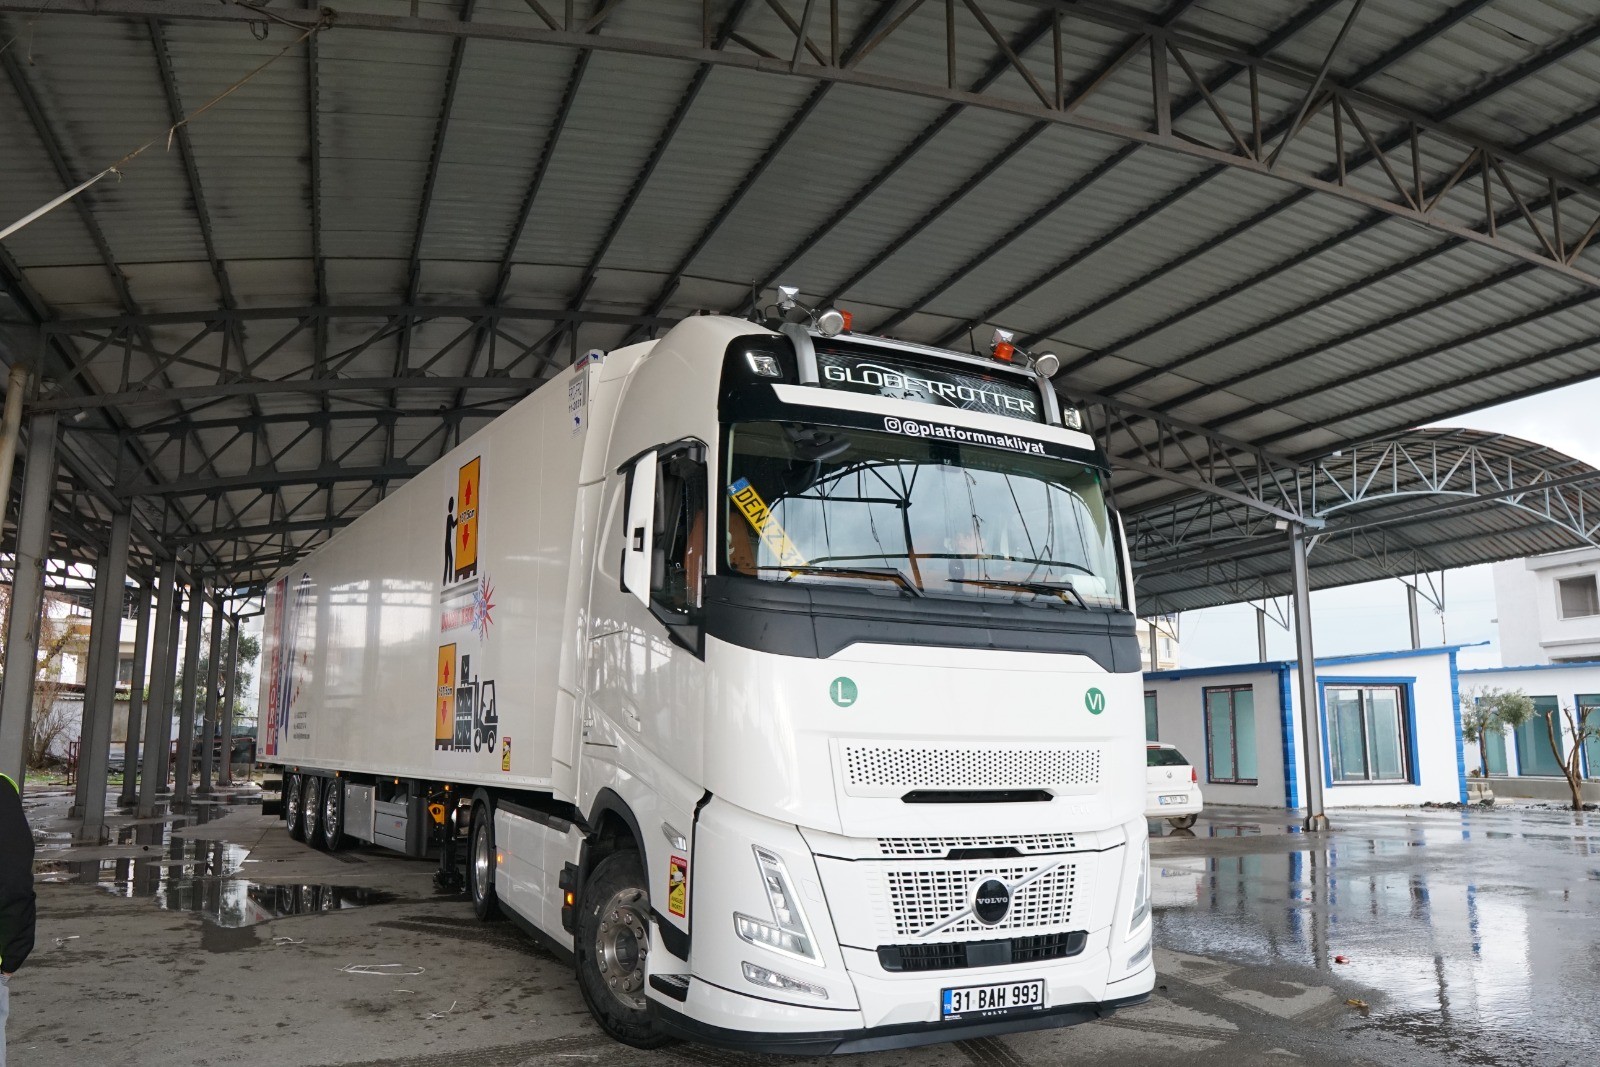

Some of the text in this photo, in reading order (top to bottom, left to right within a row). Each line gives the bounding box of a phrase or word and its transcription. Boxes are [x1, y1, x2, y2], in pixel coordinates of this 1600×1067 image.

[824, 365, 1037, 415] GLOBETROTTER
[903, 420, 1046, 455] @platformnakliyat
[837, 681, 852, 703] L
[1086, 692, 1103, 711] VI
[976, 896, 1009, 905] VOLVO
[953, 984, 1039, 1012] 31 BAH 993
